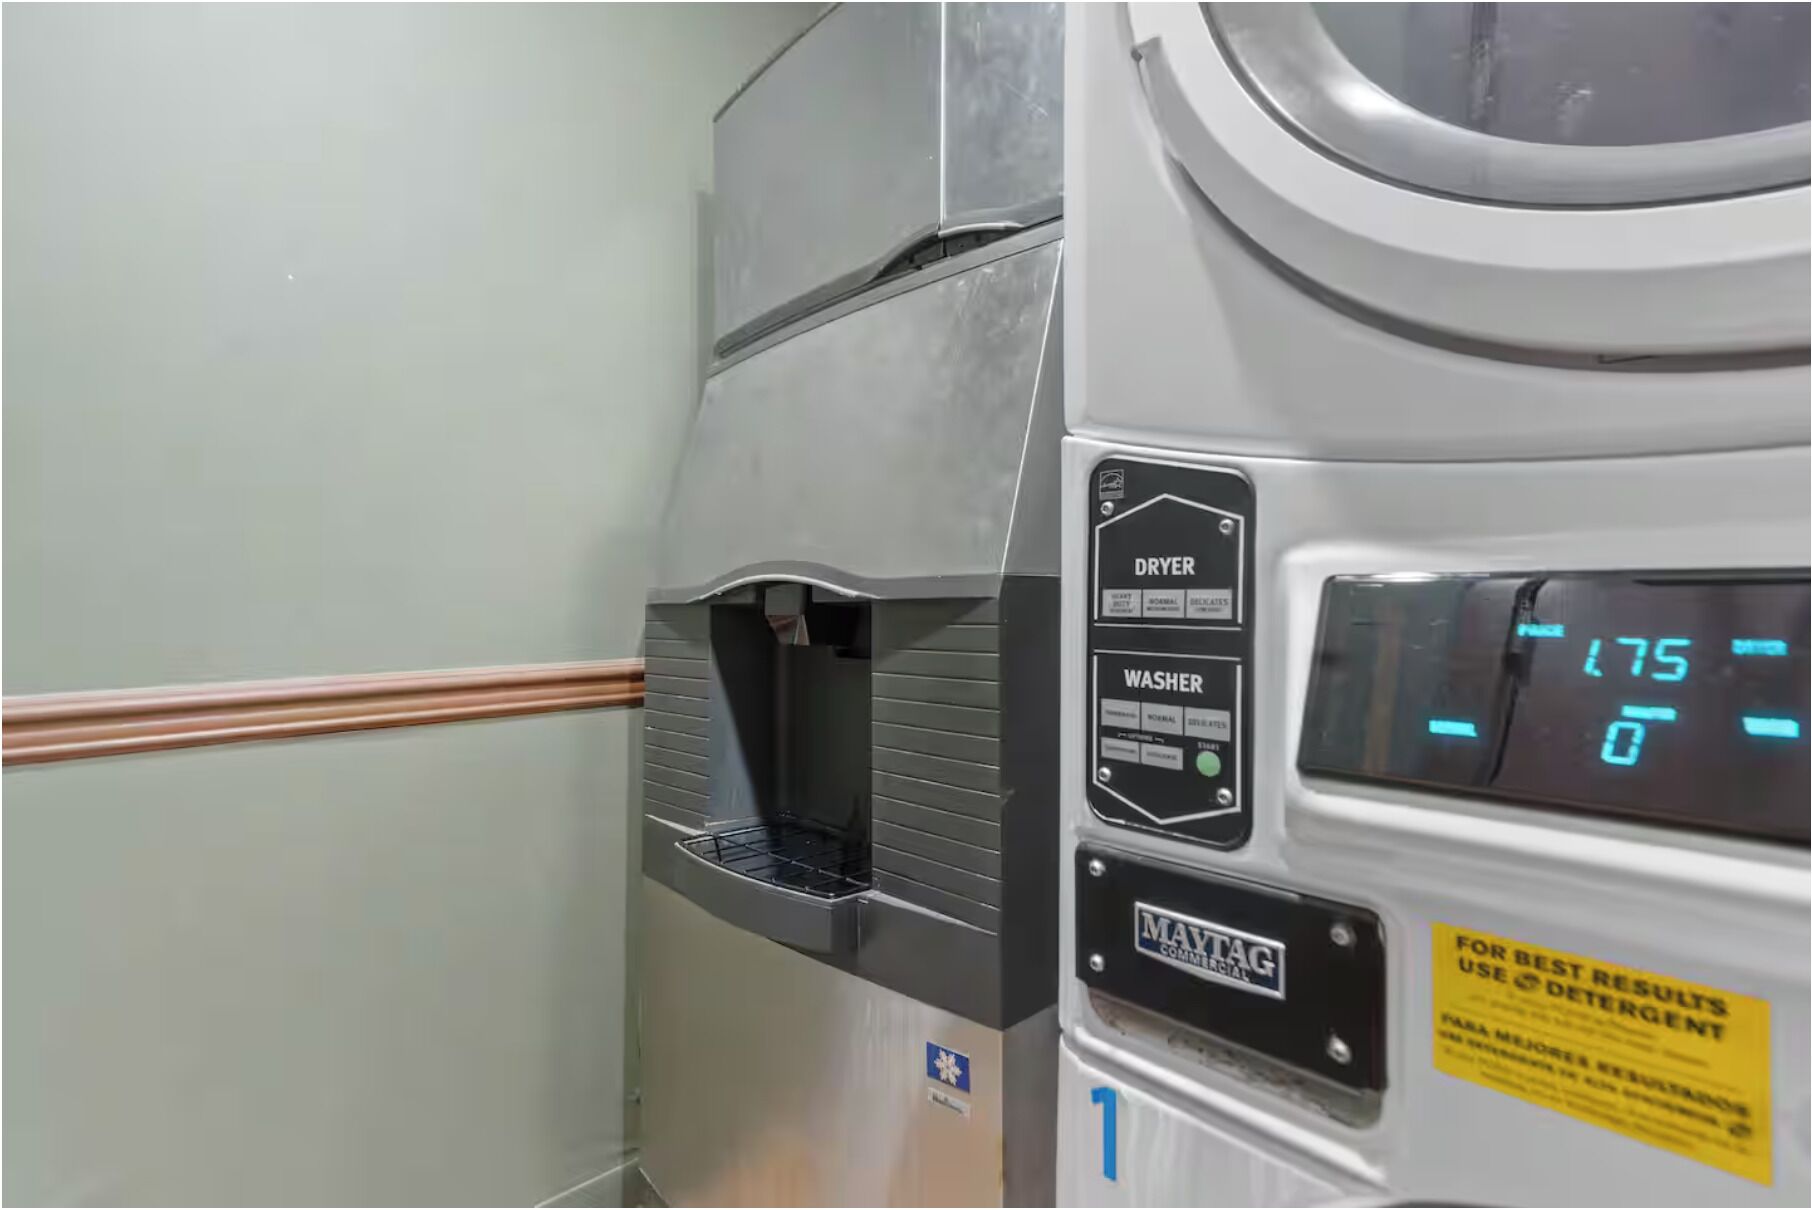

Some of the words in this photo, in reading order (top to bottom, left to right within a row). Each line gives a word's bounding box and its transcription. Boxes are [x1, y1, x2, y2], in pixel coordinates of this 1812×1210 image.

[1135, 556, 1196, 576] DRYER
[1148, 598, 1178, 606] NORMAL
[1189, 598, 1229, 606] DELICATES
[1124, 668, 1204, 694] WASHER
[1583, 637, 1693, 683] 1.75
[1147, 713, 1176, 724] NORMAL
[1141, 911, 1275, 978] MAYTAG
[1159, 944, 1251, 983] COMMERCIAL
[1455, 935, 1507, 961] FOR
[1514, 948, 1585, 980] BEST
[1591, 968, 1729, 1017] RESULTS
[1458, 957, 1508, 984] USE
[1546, 980, 1726, 1041] DETERGENT
[1441, 1012, 1490, 1038] PARA
[1495, 1027, 1590, 1068] MEJORES
[1090, 1086, 1117, 1182] 1
